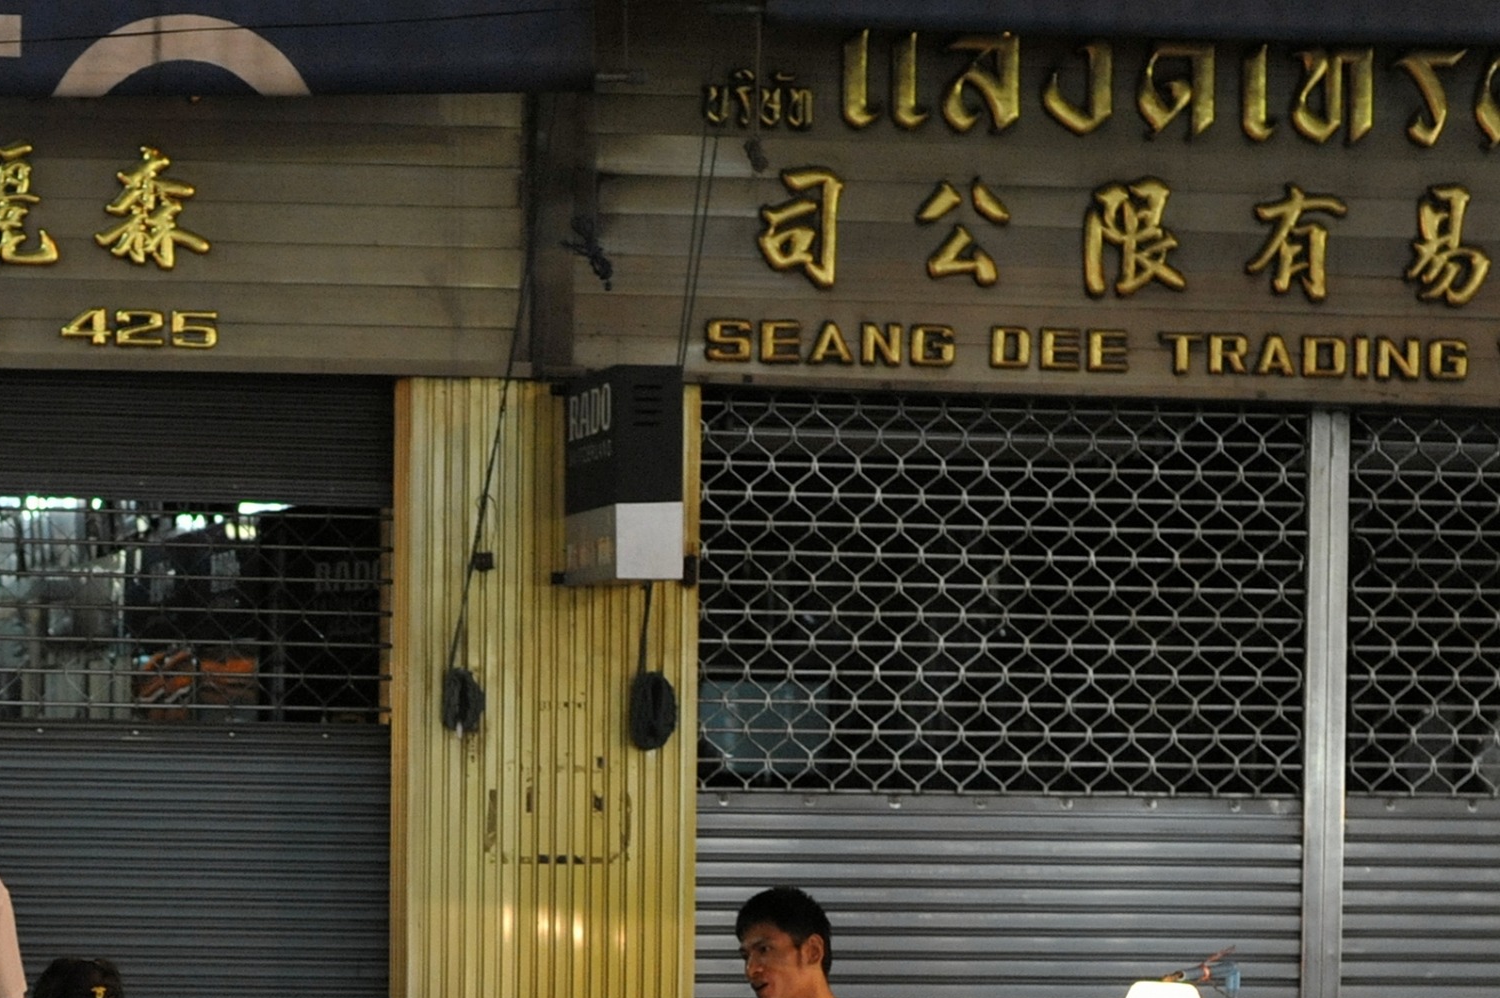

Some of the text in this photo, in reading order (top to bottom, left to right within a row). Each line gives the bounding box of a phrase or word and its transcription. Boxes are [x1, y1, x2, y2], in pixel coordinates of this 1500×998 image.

[61, 308, 218, 349] 425
[705, 318, 1469, 381] SEANG DEE TRADING
[569, 384, 611, 440] RADO
